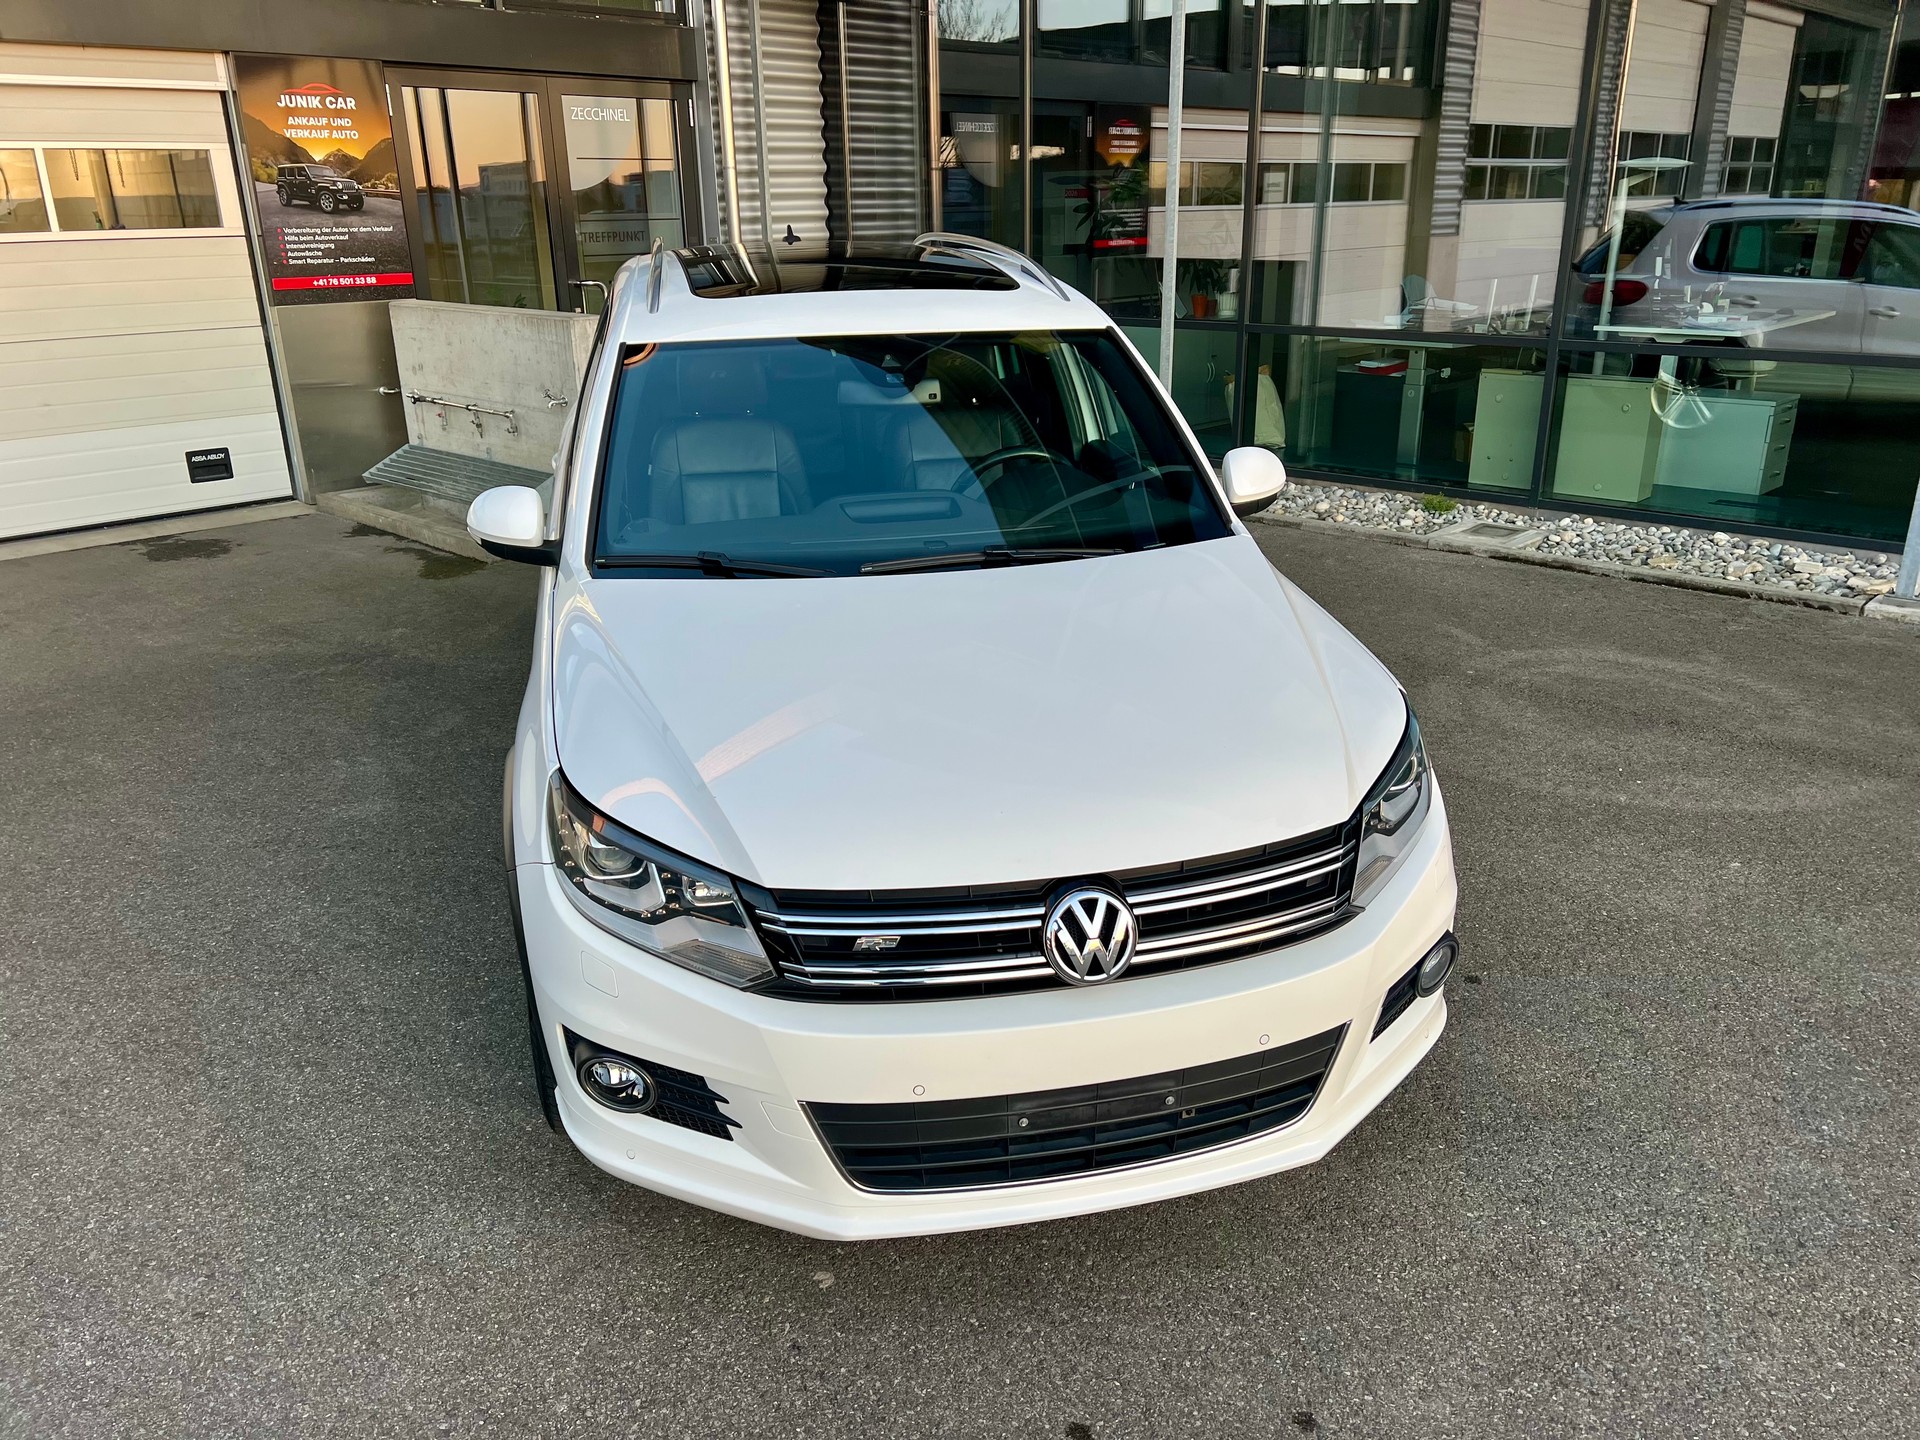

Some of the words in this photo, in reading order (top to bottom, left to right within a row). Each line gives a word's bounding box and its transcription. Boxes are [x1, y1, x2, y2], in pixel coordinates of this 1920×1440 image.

[276, 94, 323, 109] JUNIK
[325, 96, 357, 110] CAR
[571, 107, 630, 122] ZECCHINEL
[287, 116, 329, 126] ANKAUF
[330, 117, 352, 127] UND
[283, 128, 330, 138] VERKAUF
[332, 130, 359, 140] AUTO
[582, 231, 645, 243] TREFFPUNKT
[306, 257, 334, 265] Reparatur
[313, 278, 327, 286] +41
[328, 277, 339, 286] 76
[339, 277, 354, 285] 501
[354, 276, 366, 285] 33
[366, 276, 377, 284] 88
[207, 453, 225, 461] ABLOY
[1047, 888, 1136, 983] VW
